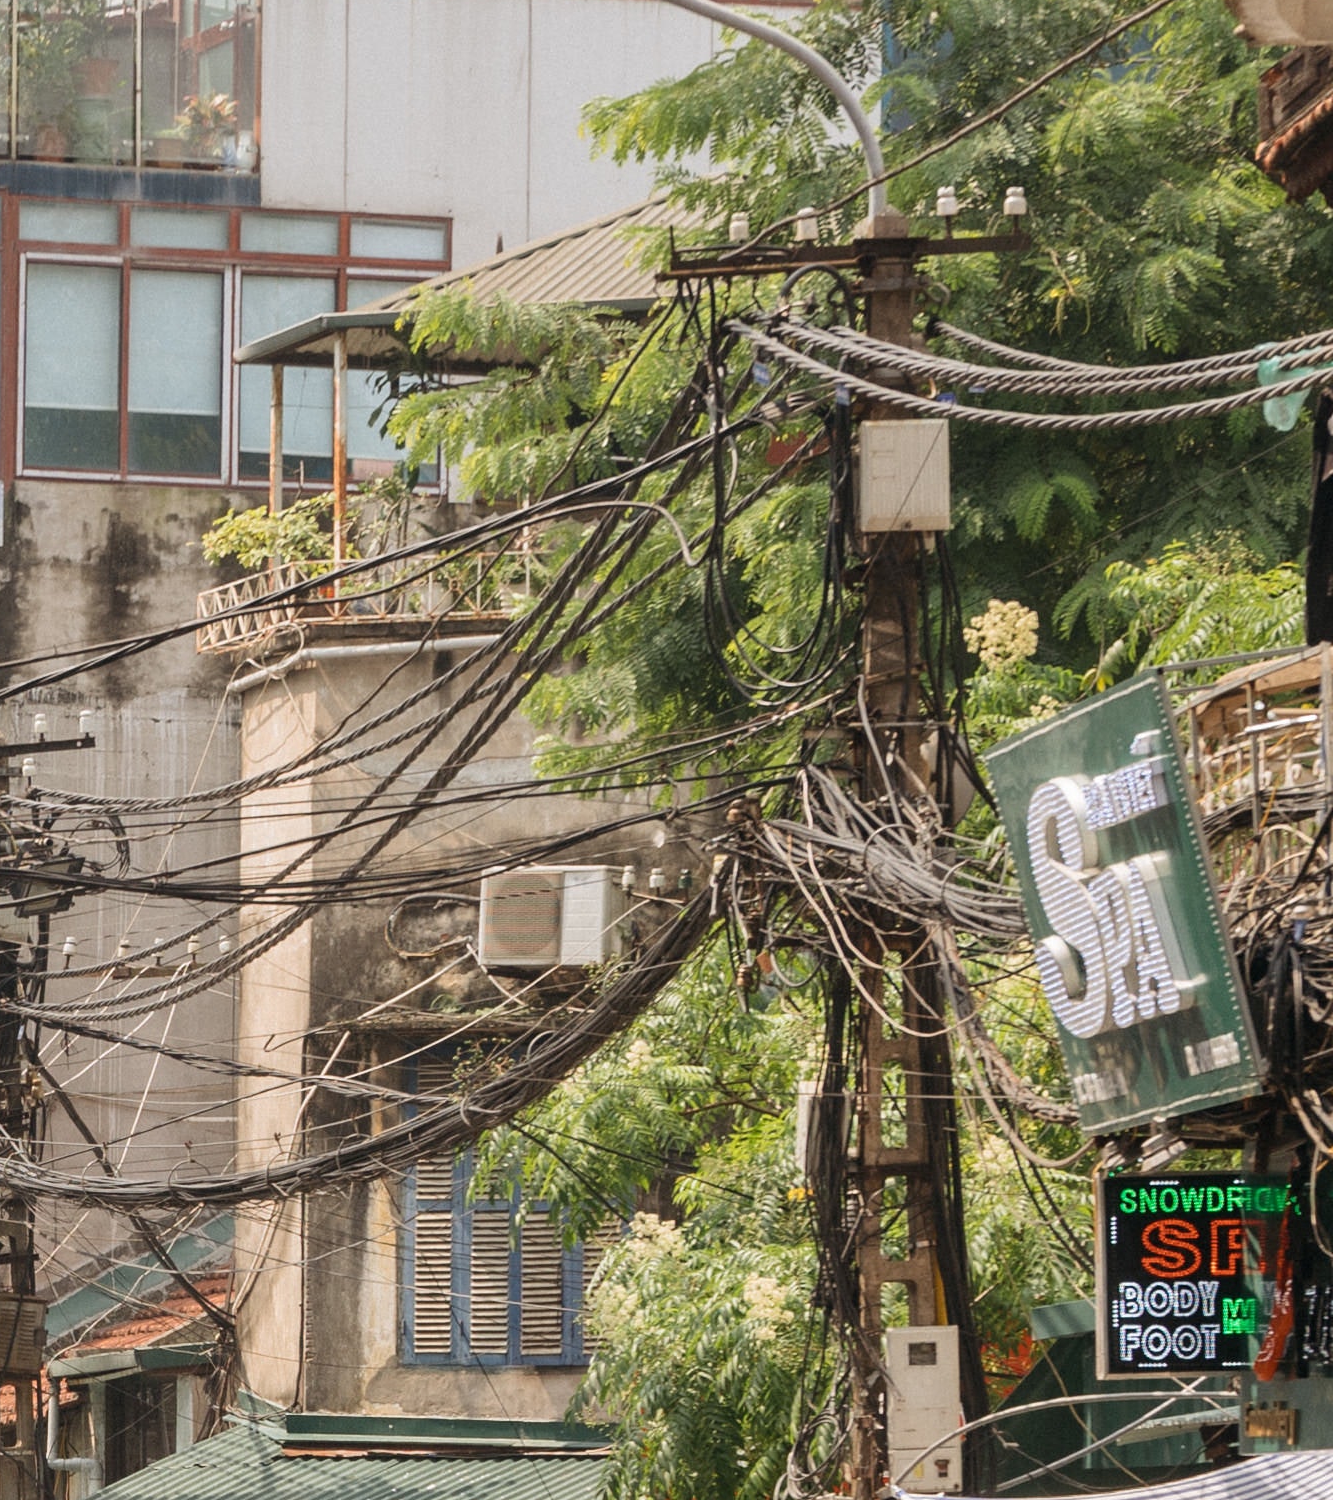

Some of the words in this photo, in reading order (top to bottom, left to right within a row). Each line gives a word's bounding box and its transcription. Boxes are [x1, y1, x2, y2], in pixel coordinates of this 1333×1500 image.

[1026, 776, 1191, 1042] SPA
[1119, 1281, 1220, 1318] BODY
[1118, 1323, 1221, 1362] FOOT
